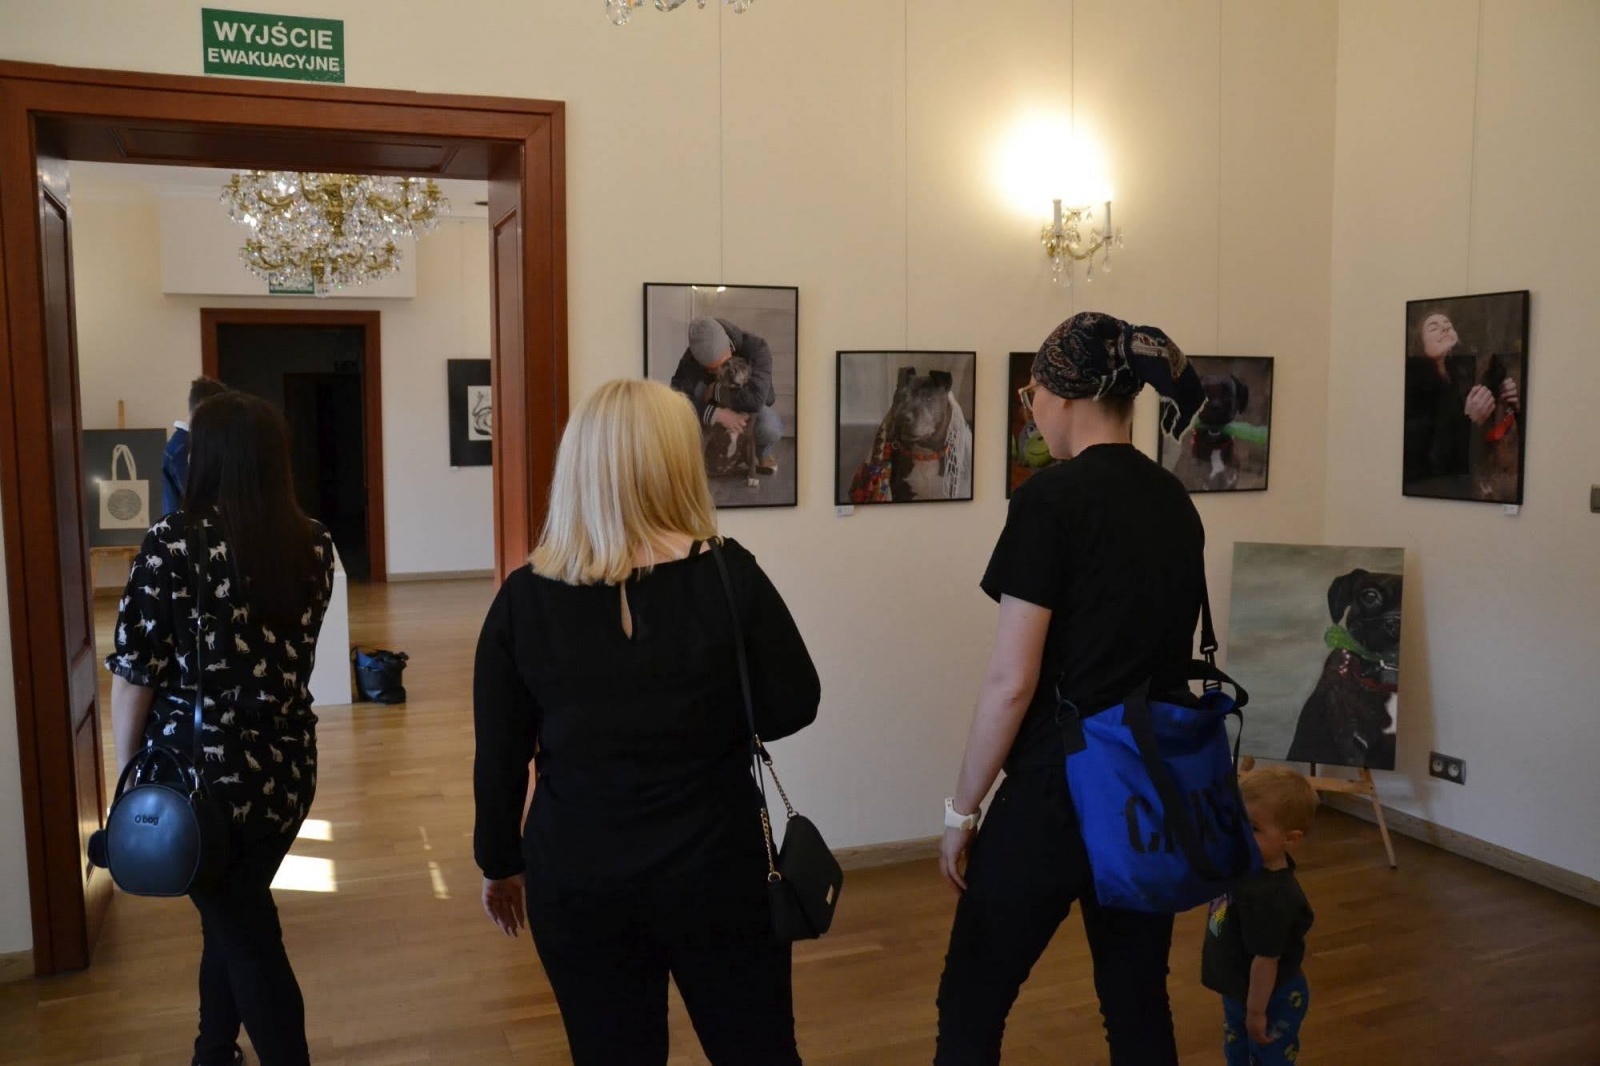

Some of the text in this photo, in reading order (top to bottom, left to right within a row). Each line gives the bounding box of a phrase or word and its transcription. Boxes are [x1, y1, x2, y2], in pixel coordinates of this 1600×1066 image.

[213, 21, 333, 50] WYJŚCIE
[207, 47, 340, 72] EWAKUACYJNE
[134, 814, 160, 826] O bag
